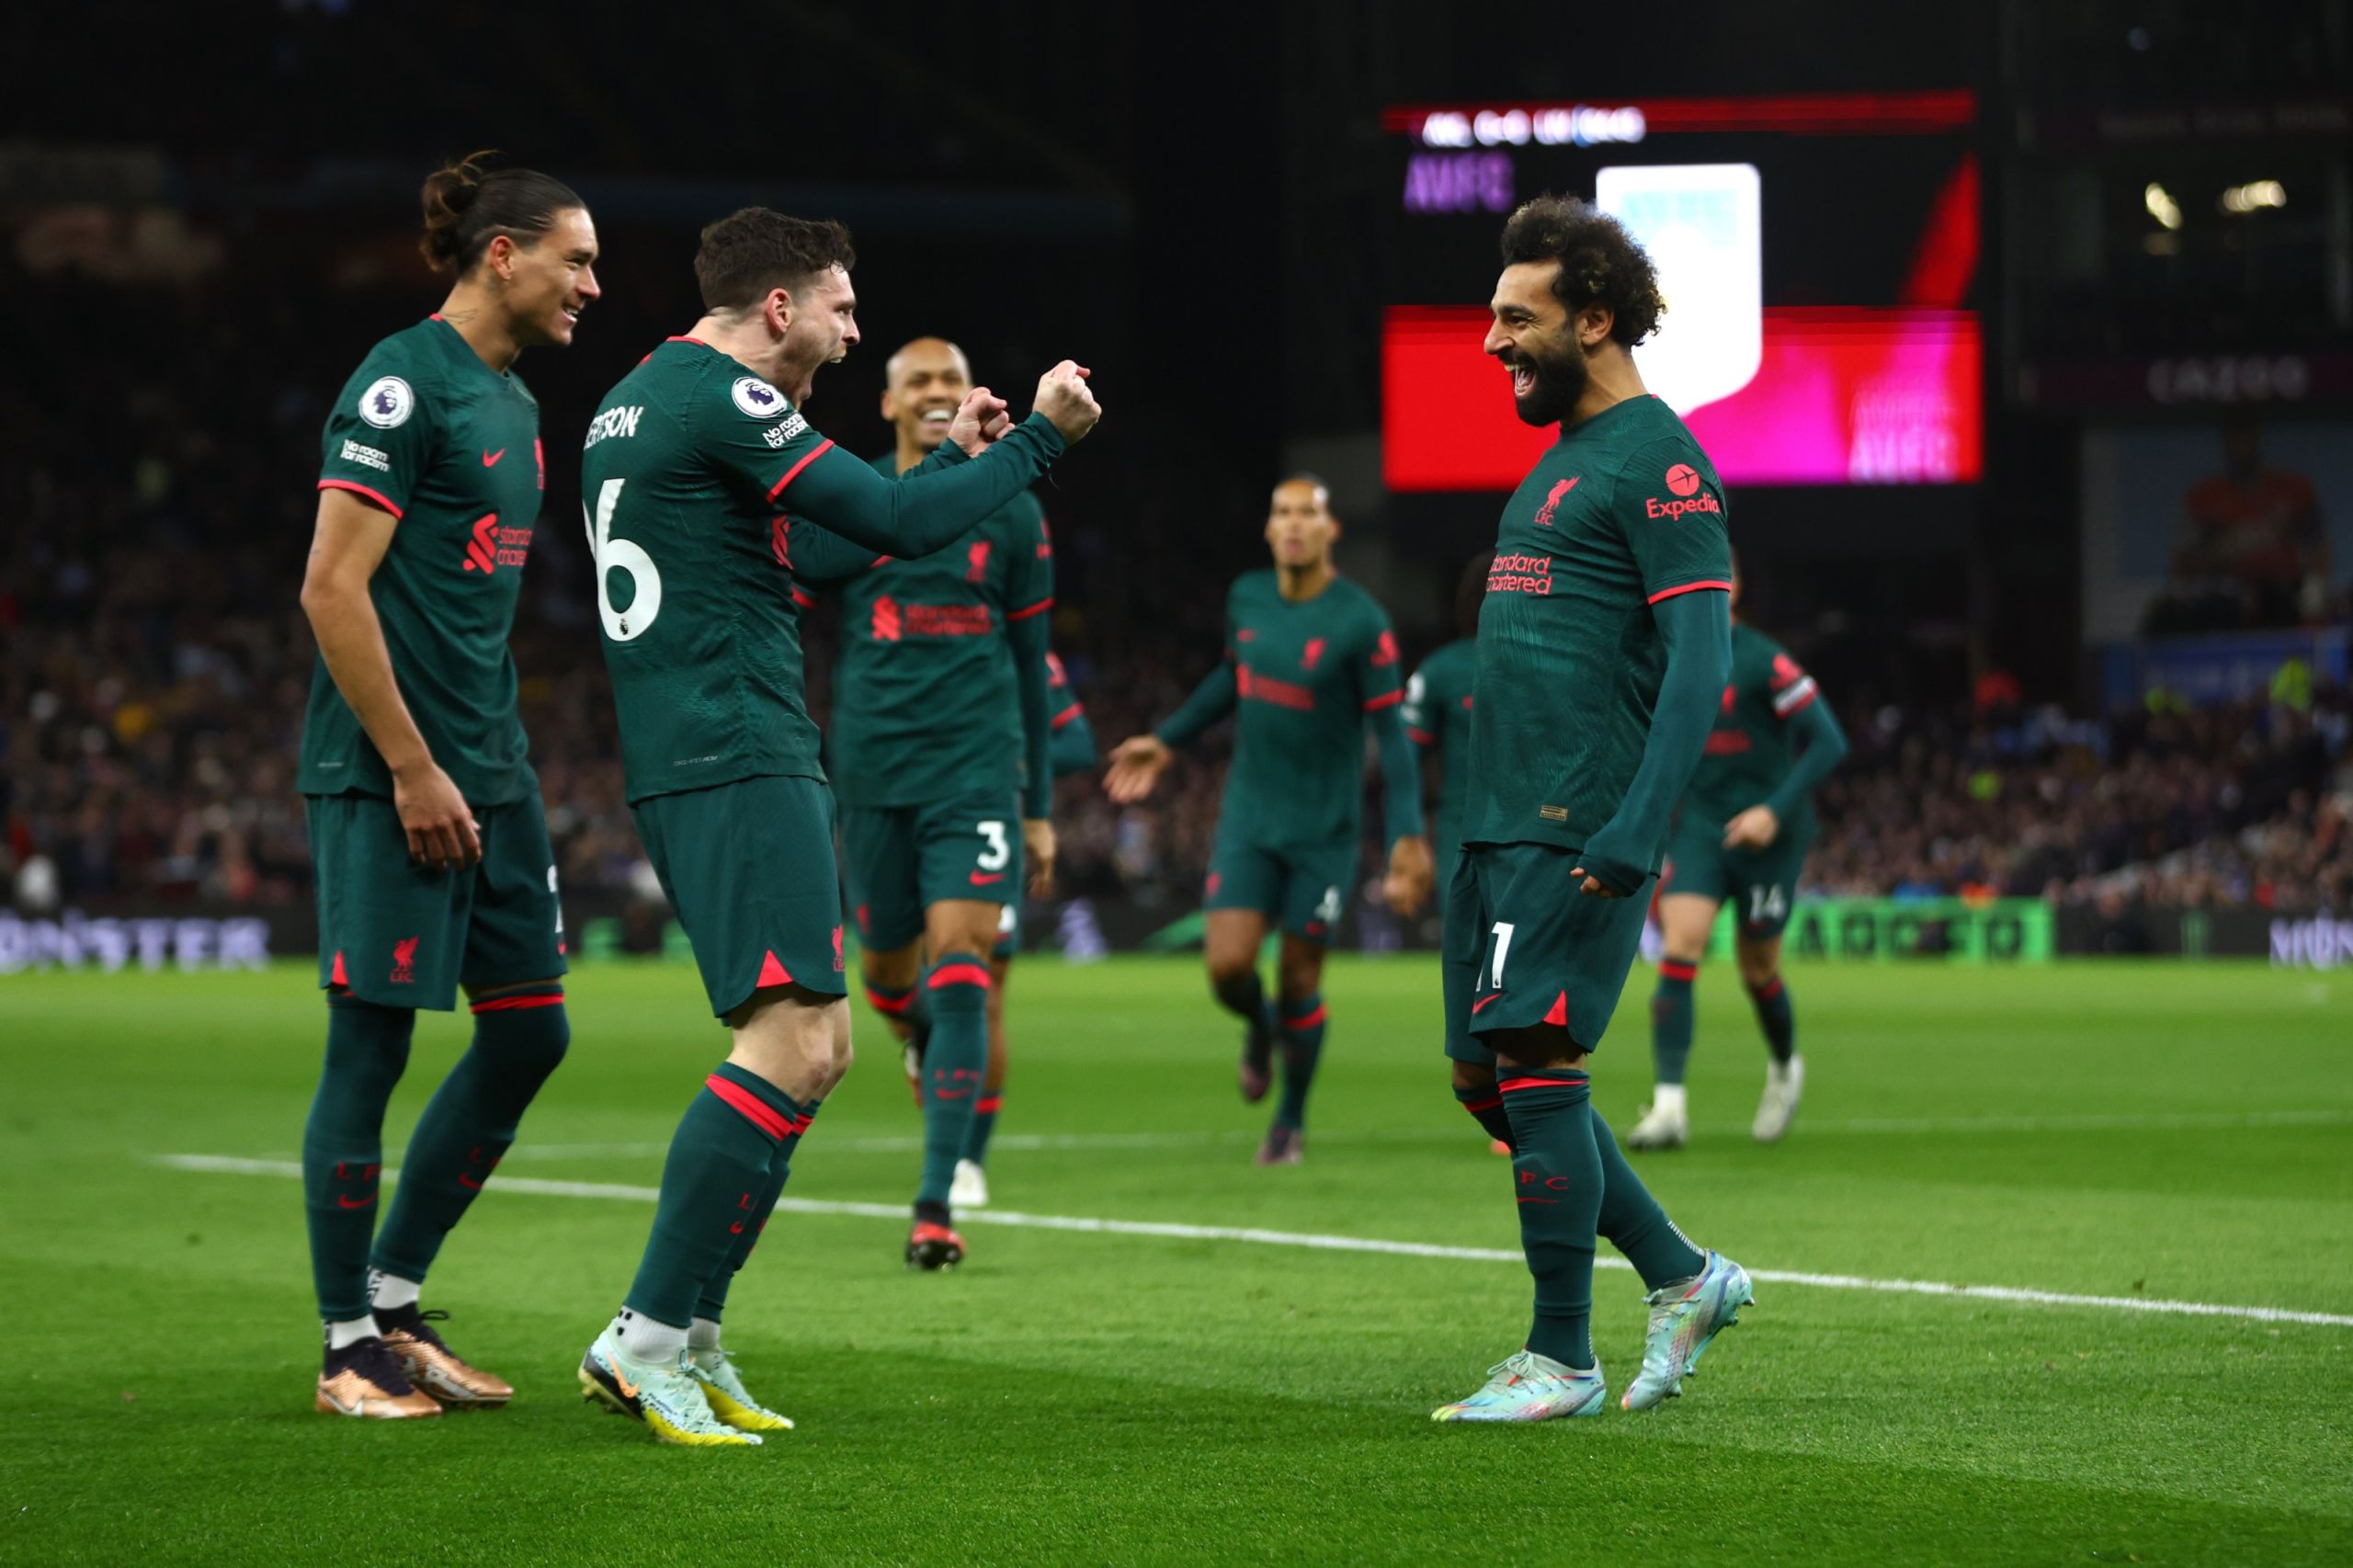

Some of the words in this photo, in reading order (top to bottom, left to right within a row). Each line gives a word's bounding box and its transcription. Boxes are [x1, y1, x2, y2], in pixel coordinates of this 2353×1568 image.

[1646, 492, 1721, 521] Expedia
[582, 477, 662, 642] 6
[976, 820, 1009, 870] 3
